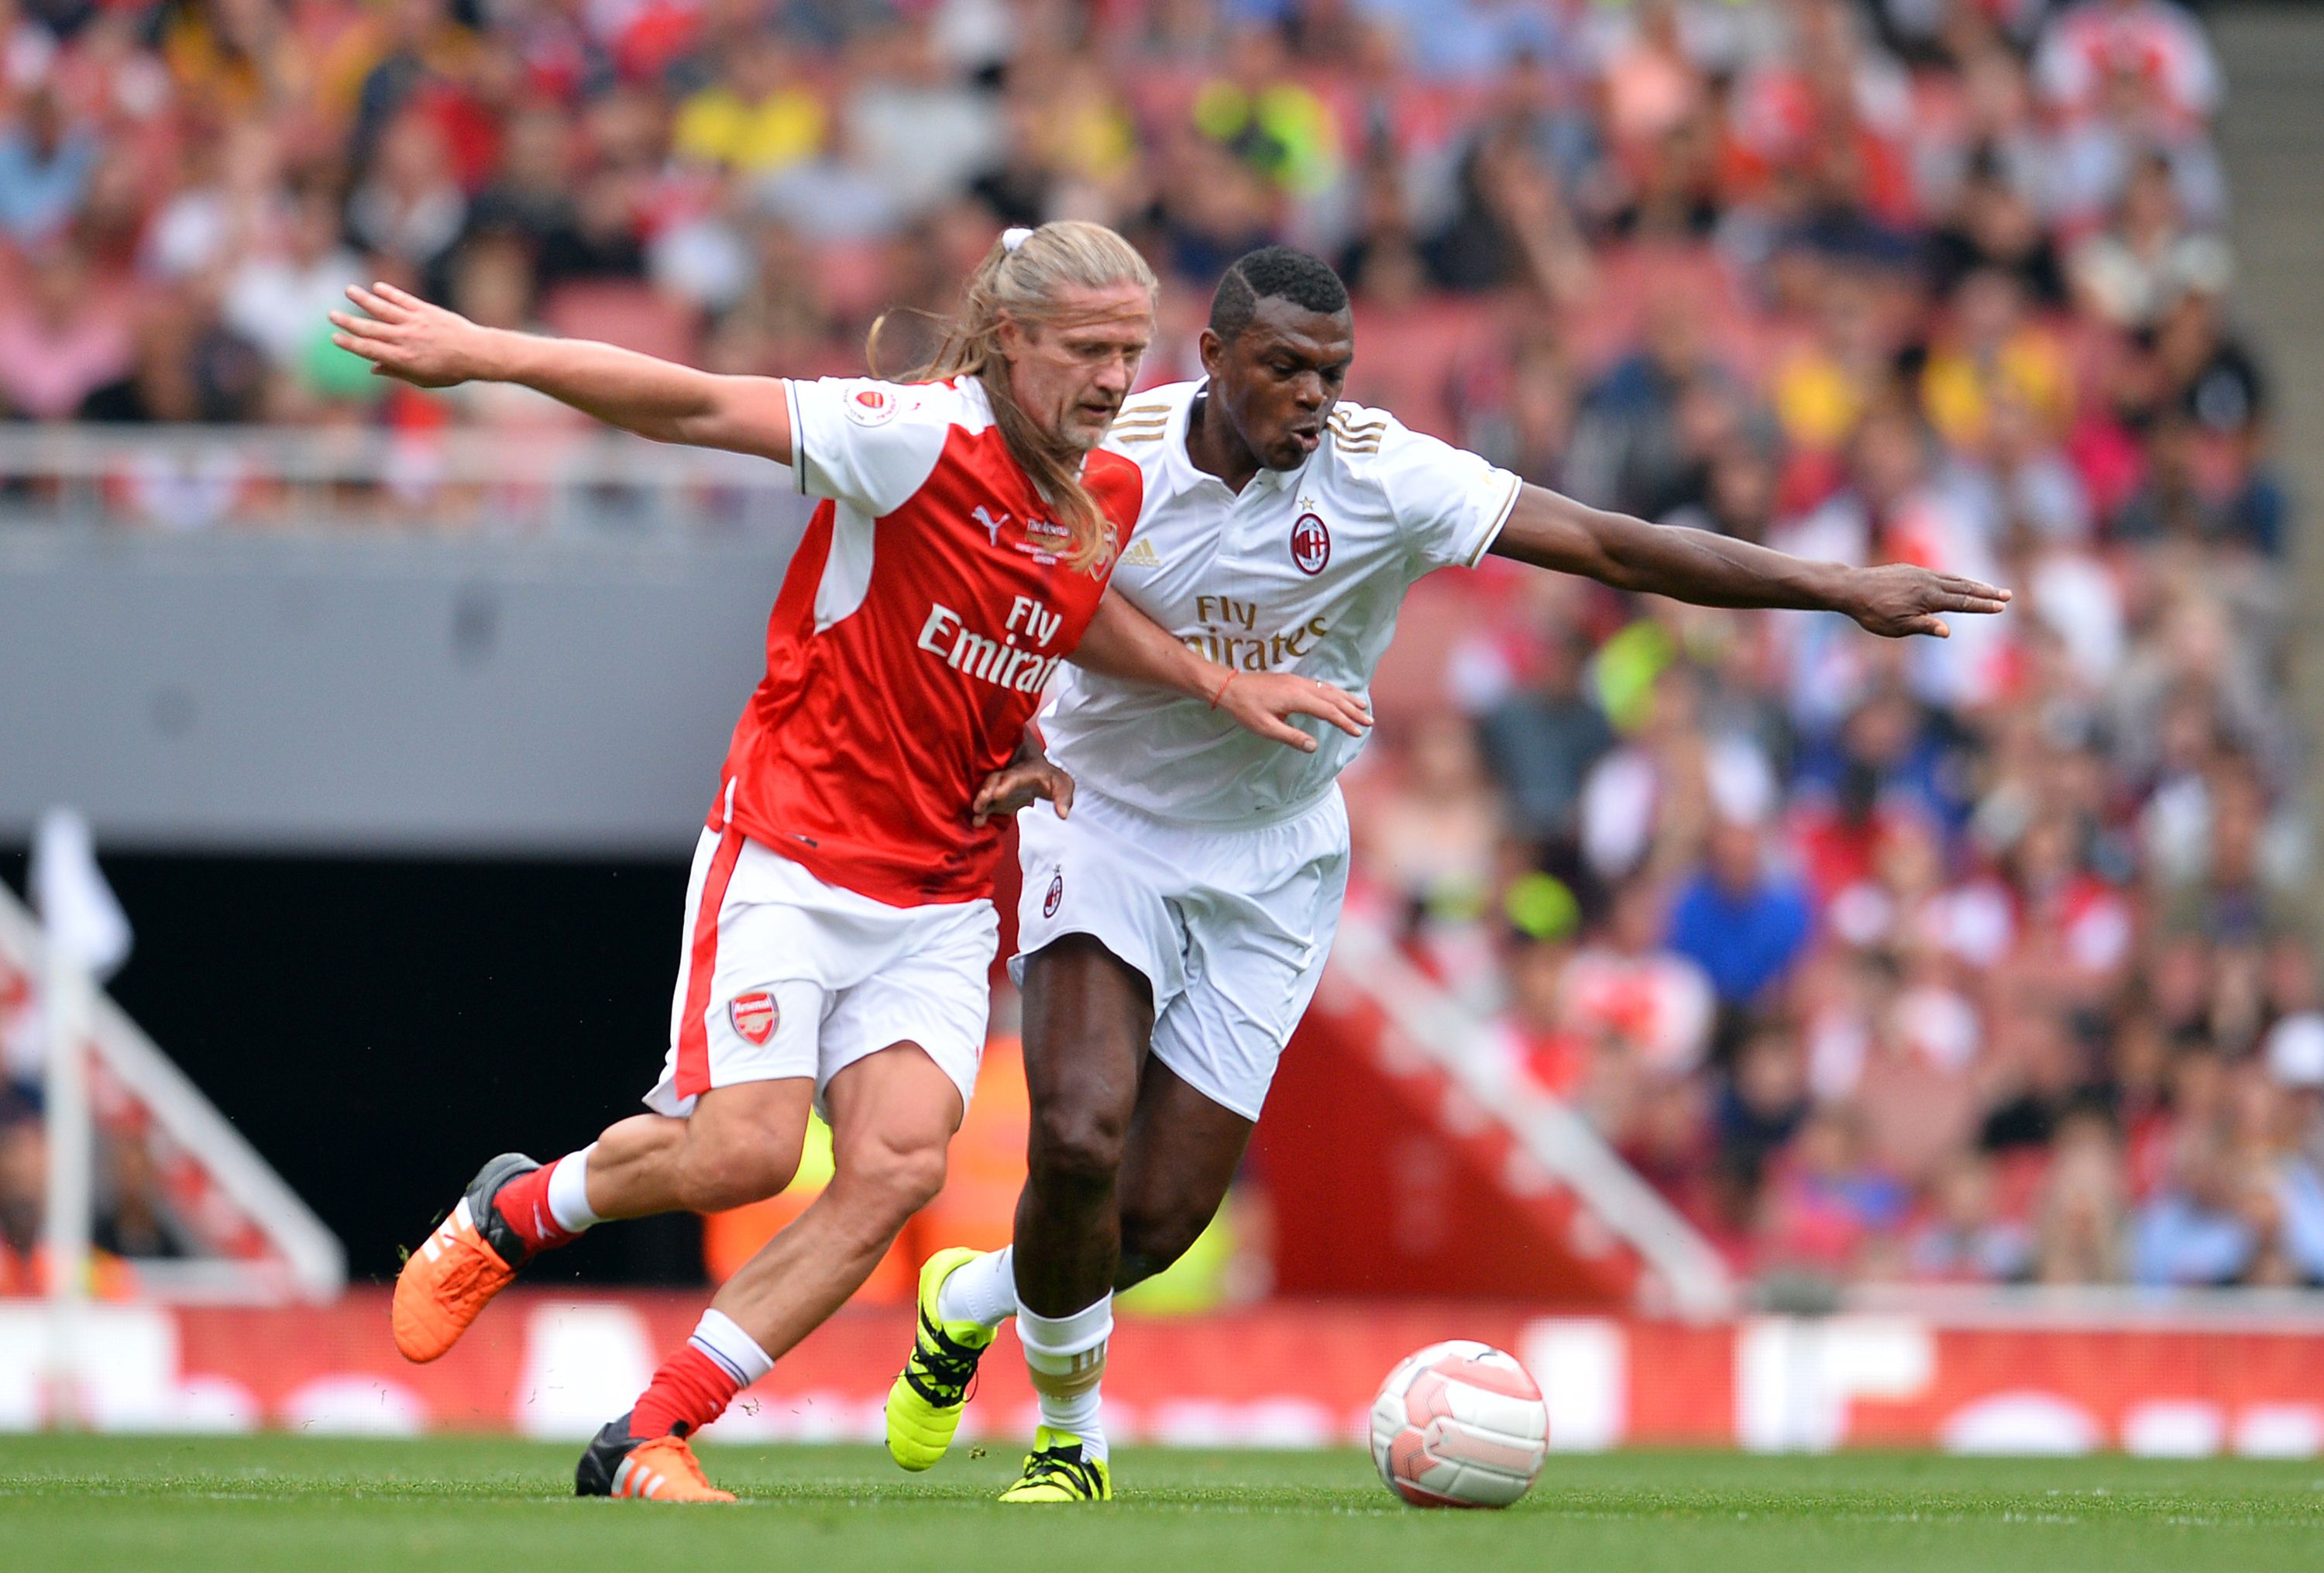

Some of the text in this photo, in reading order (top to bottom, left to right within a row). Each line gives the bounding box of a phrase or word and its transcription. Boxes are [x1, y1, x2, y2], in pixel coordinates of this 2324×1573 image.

[1006, 595, 1063, 648] Fly
[1195, 595, 1257, 631] Fly
[917, 602, 1061, 694] Emirat
